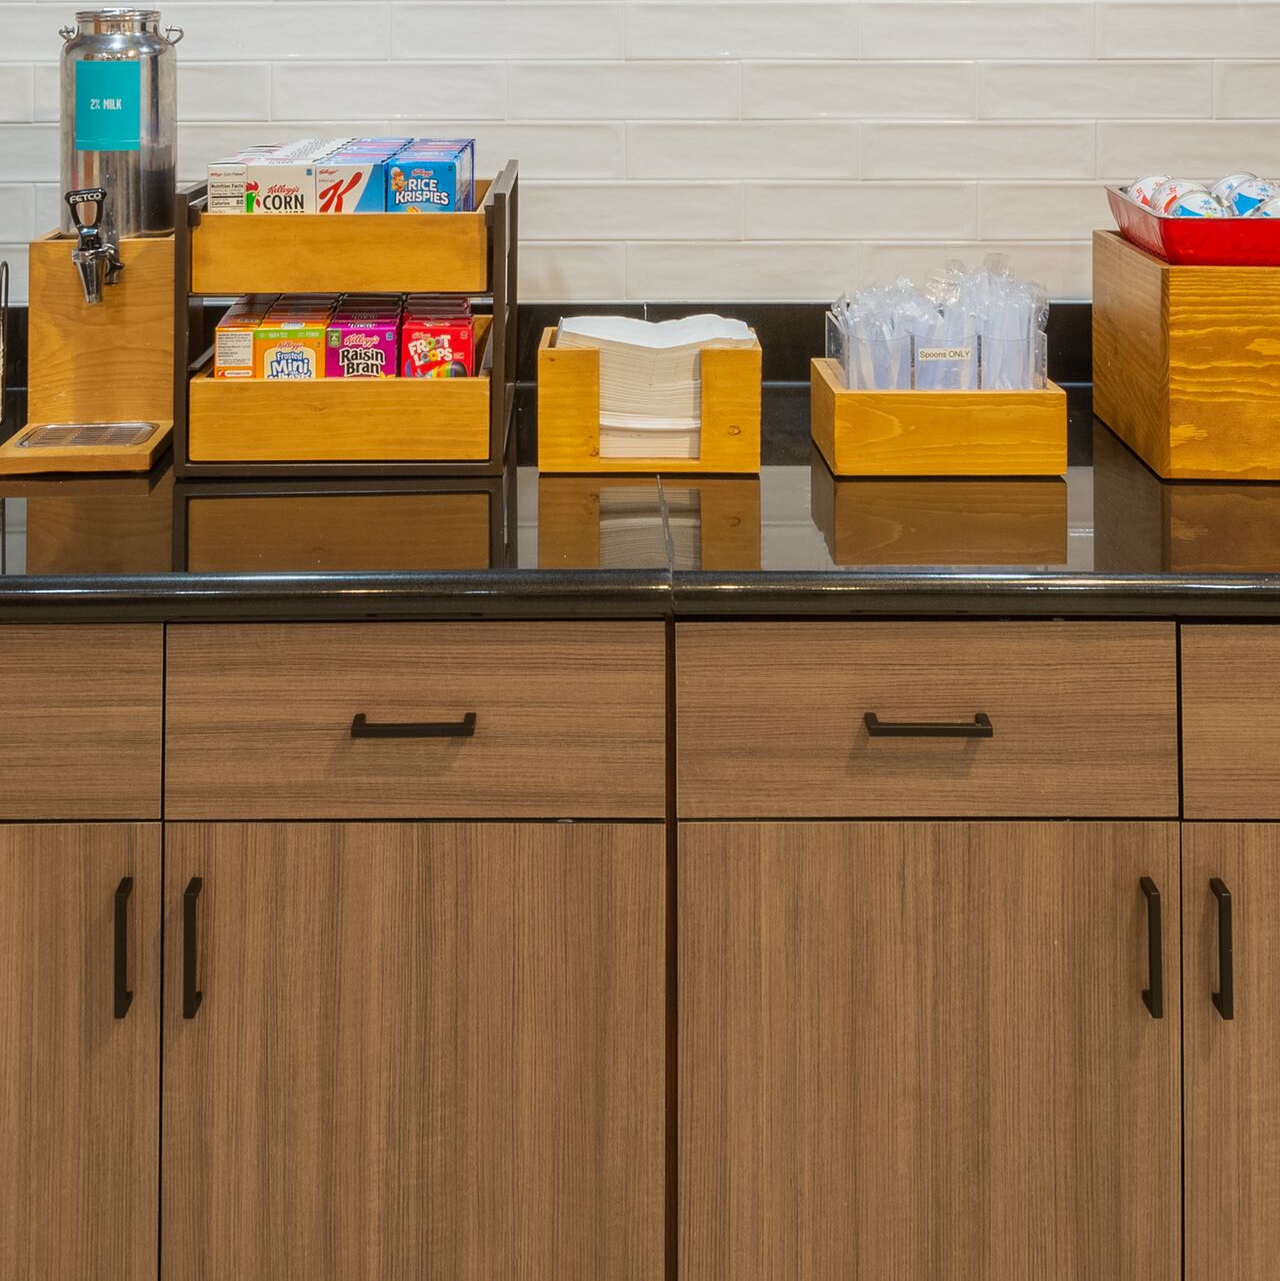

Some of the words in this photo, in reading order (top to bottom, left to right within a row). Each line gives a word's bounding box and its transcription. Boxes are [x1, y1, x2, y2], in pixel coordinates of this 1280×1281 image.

[90, 99, 100, 110] 2%
[103, 99, 122, 110] MILK
[408, 179, 437, 191] RICE
[69, 192, 101, 204] FETCO
[263, 194, 305, 210] CORN
[395, 191, 449, 205] KRISPIES
[408, 335, 451, 356] FROOT
[276, 351, 304, 360] Frosted
[341, 348, 384, 364] Raisin
[413, 348, 453, 367] LOOPS
[920, 350, 947, 358] Spoons
[948, 350, 970, 358] ONLY
[271, 359, 309, 375] Mini
[345, 362, 380, 377] Bran
